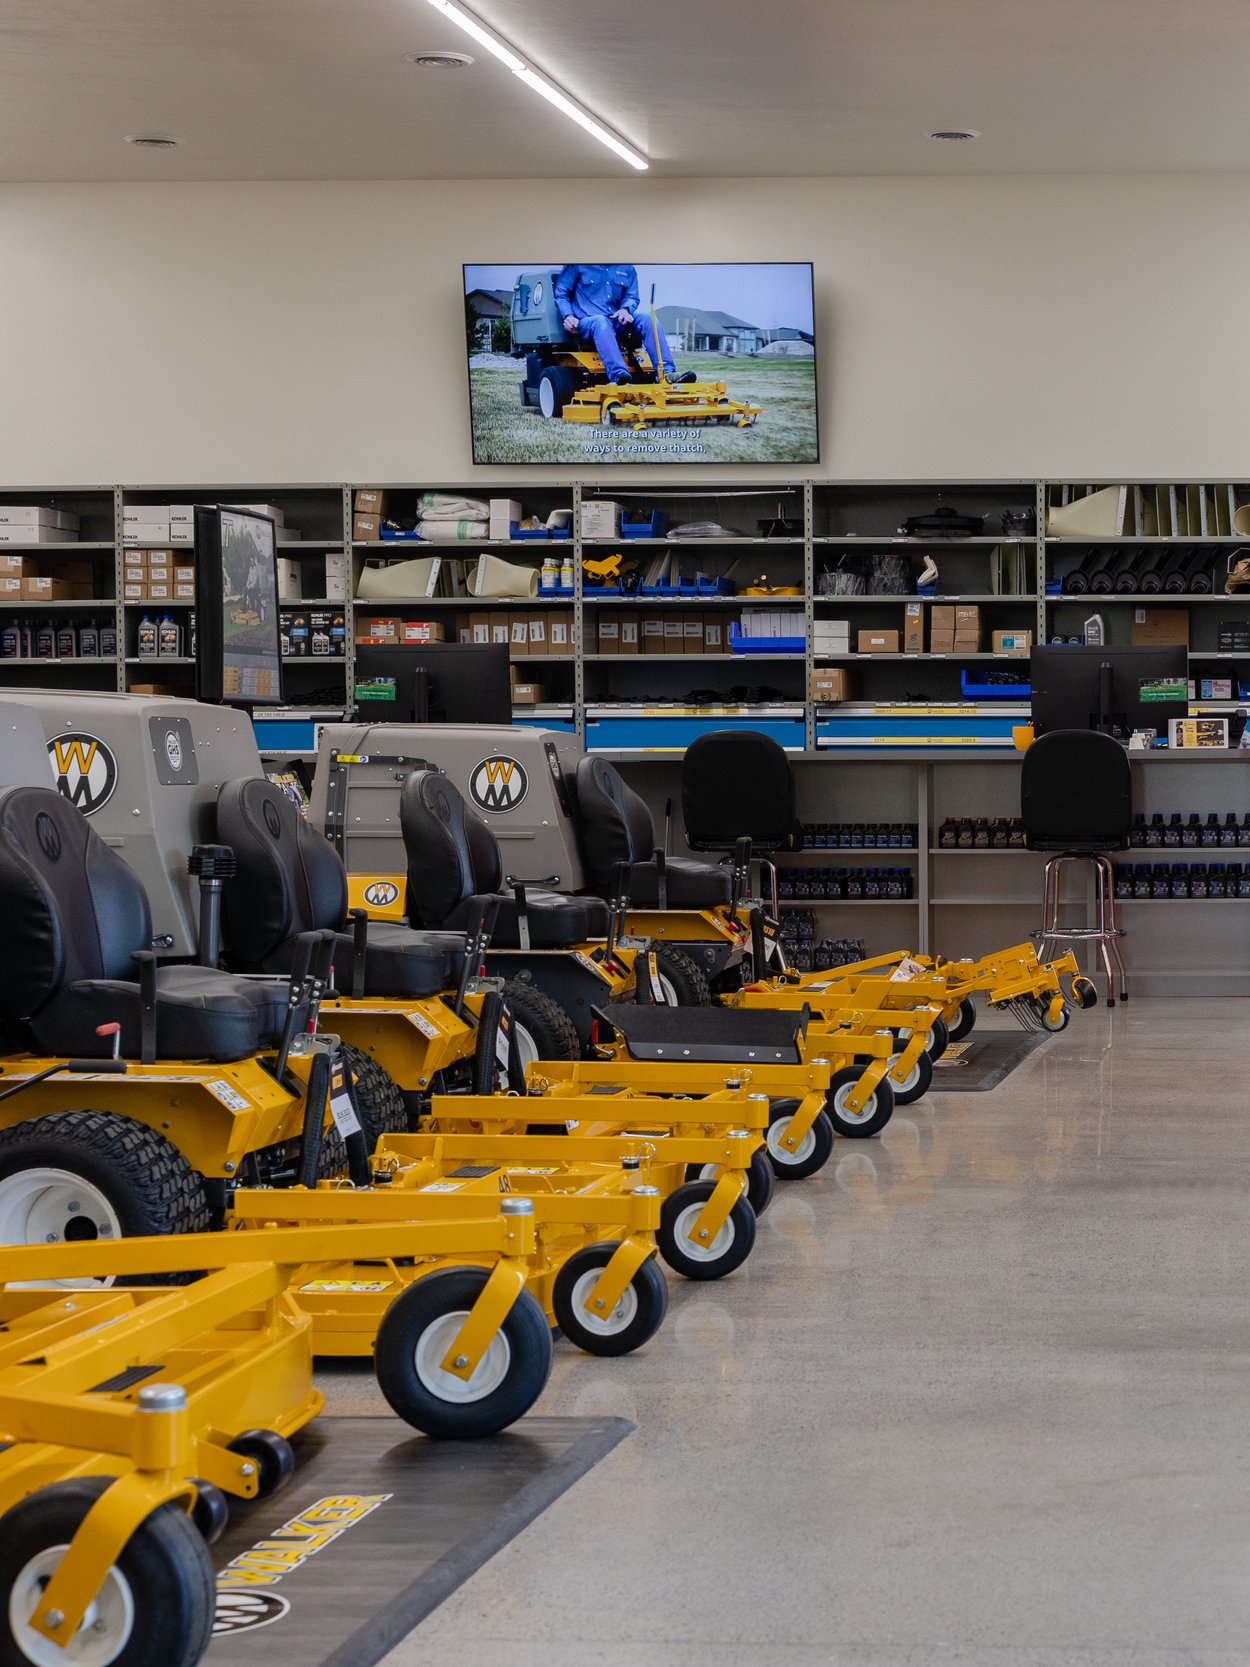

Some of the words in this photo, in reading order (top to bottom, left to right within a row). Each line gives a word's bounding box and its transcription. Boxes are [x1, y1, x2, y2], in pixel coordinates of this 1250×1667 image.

[588, 429, 619, 439] There
[621, 430, 641, 439] are
[641, 430, 649, 438] a
[650, 429, 687, 440] variety
[689, 429, 701, 439] of
[584, 444, 611, 454] ways
[613, 444, 624, 453] to
[627, 444, 667, 453] remove
[669, 443, 706, 454] thatch,
[216, 1493, 394, 1590] WALKER
